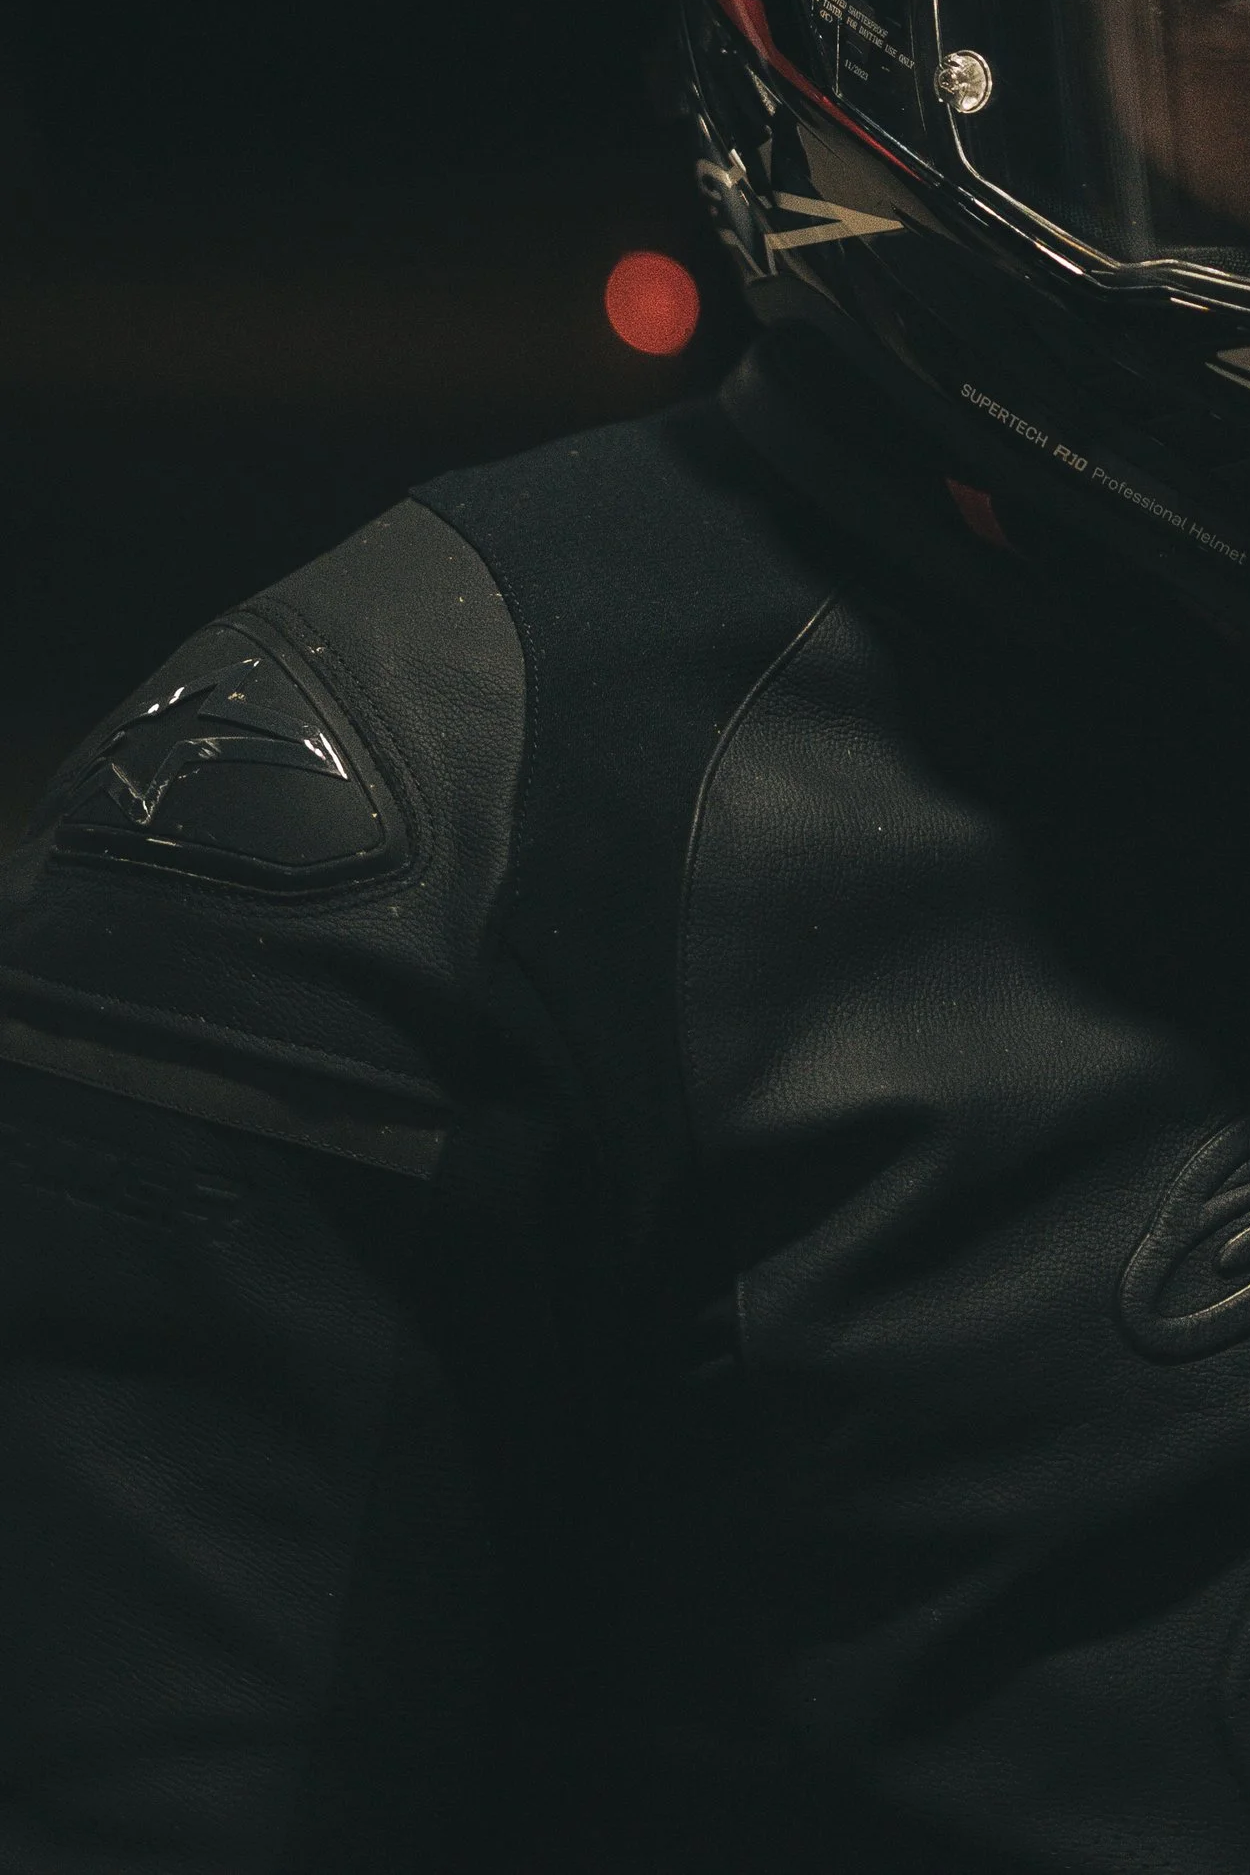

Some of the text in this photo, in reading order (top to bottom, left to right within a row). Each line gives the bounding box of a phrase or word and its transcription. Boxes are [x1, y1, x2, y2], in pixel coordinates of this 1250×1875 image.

[846, 16, 858, 30] FOR
[858, 25, 884, 49] DAYTIME
[884, 44, 897, 58] USE
[898, 54, 915, 70] ONLY
[959, 382, 1248, 566] SUPERTECH R10 Professional Helmet
